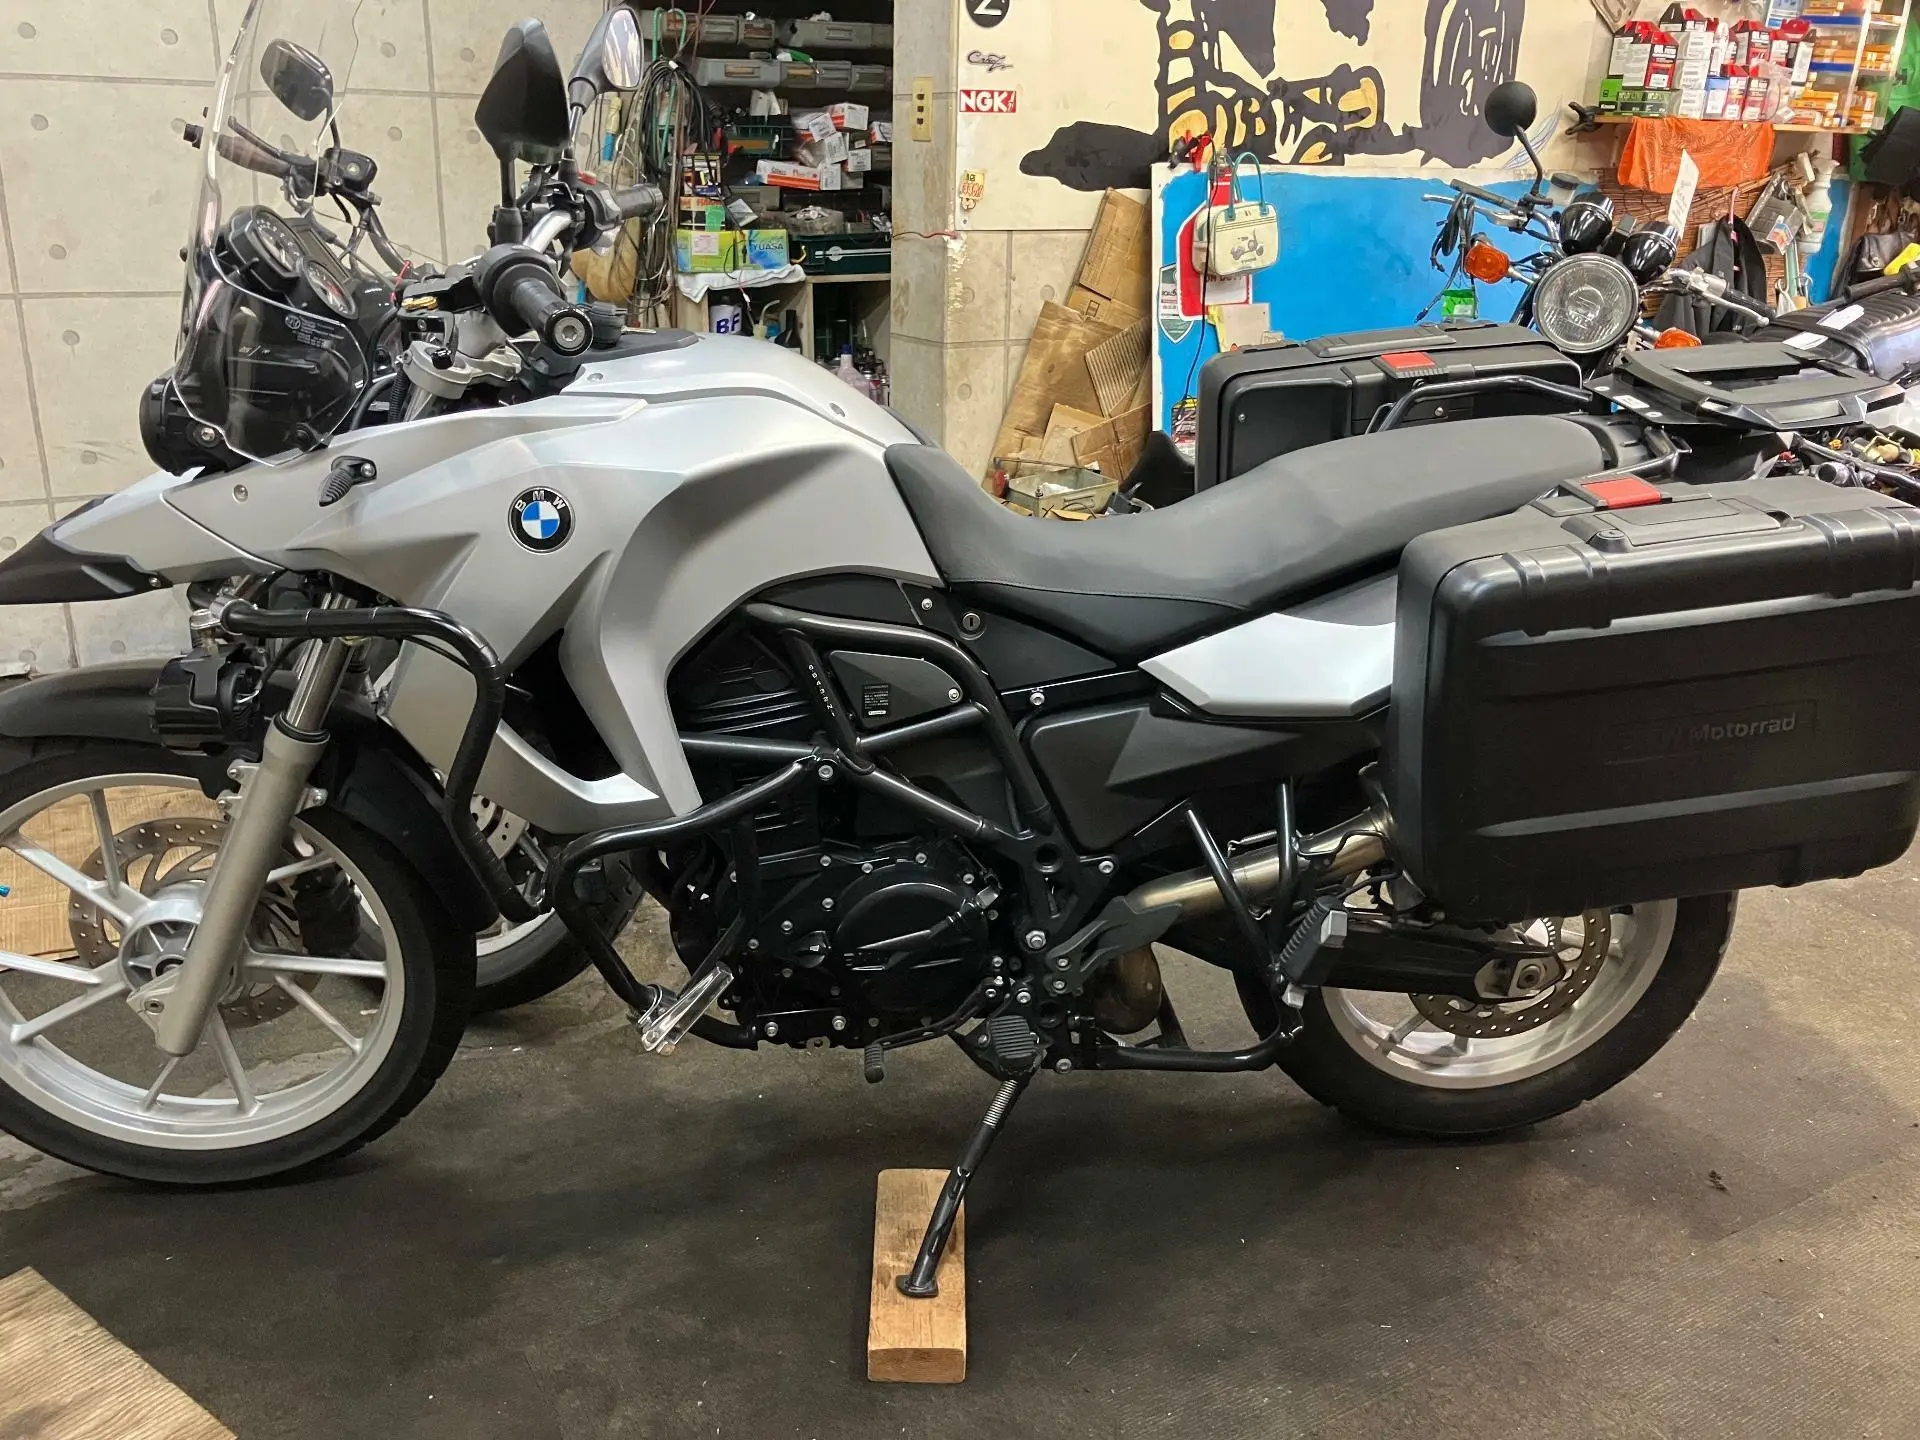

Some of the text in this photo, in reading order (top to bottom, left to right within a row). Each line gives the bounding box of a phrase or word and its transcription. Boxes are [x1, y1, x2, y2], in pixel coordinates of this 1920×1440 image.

[960, 90, 1009, 113] NGK
[752, 242, 784, 251] YUASA
[515, 490, 566, 512] BMW
[1689, 712, 1797, 743] Motorrad
